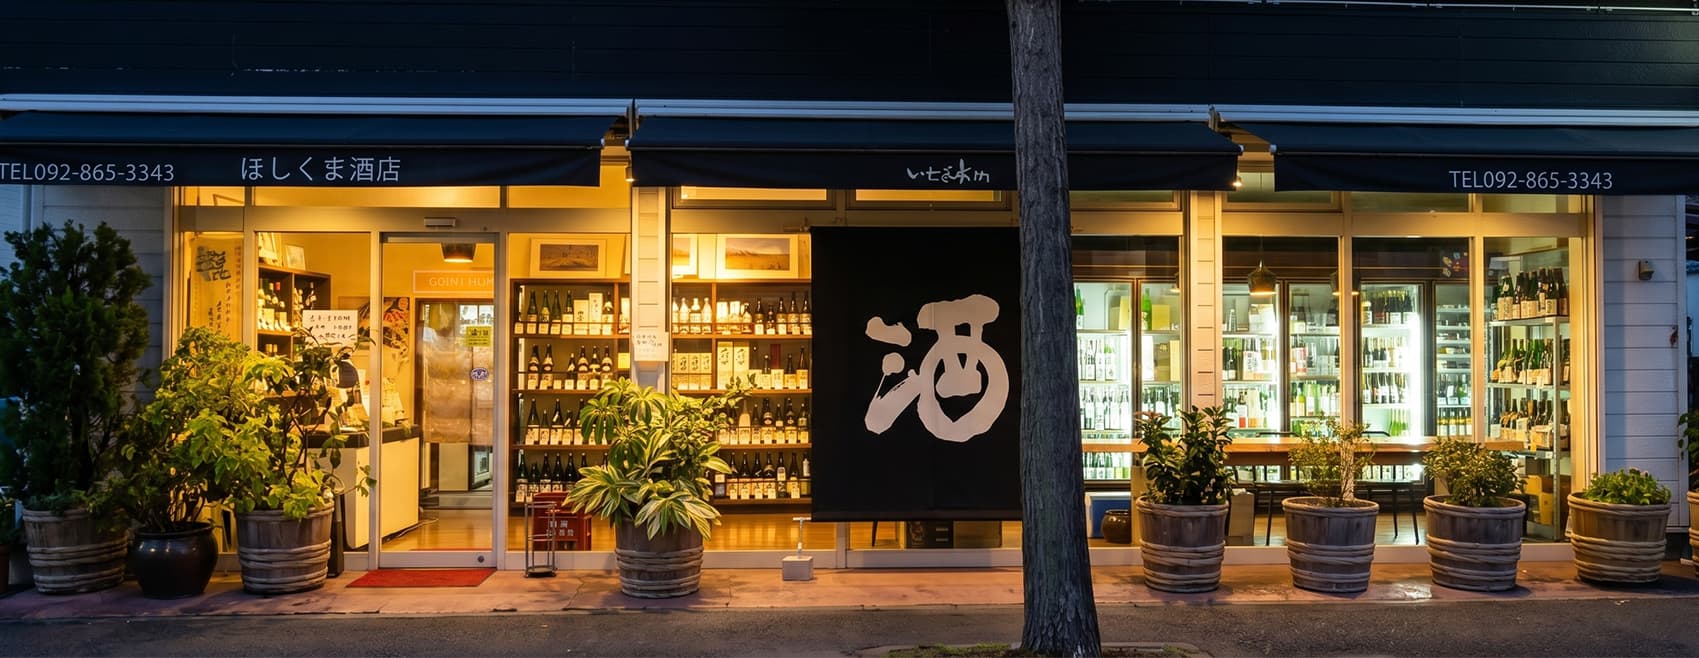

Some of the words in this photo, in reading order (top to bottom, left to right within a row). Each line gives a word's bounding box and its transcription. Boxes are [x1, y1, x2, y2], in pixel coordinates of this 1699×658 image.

[0, 163, 174, 181] TEL092-865-3343
[241, 156, 401, 182] ほしくま酒店
[1449, 170, 1613, 190] TEL092-865-3343
[864, 294, 1010, 443] 酒
